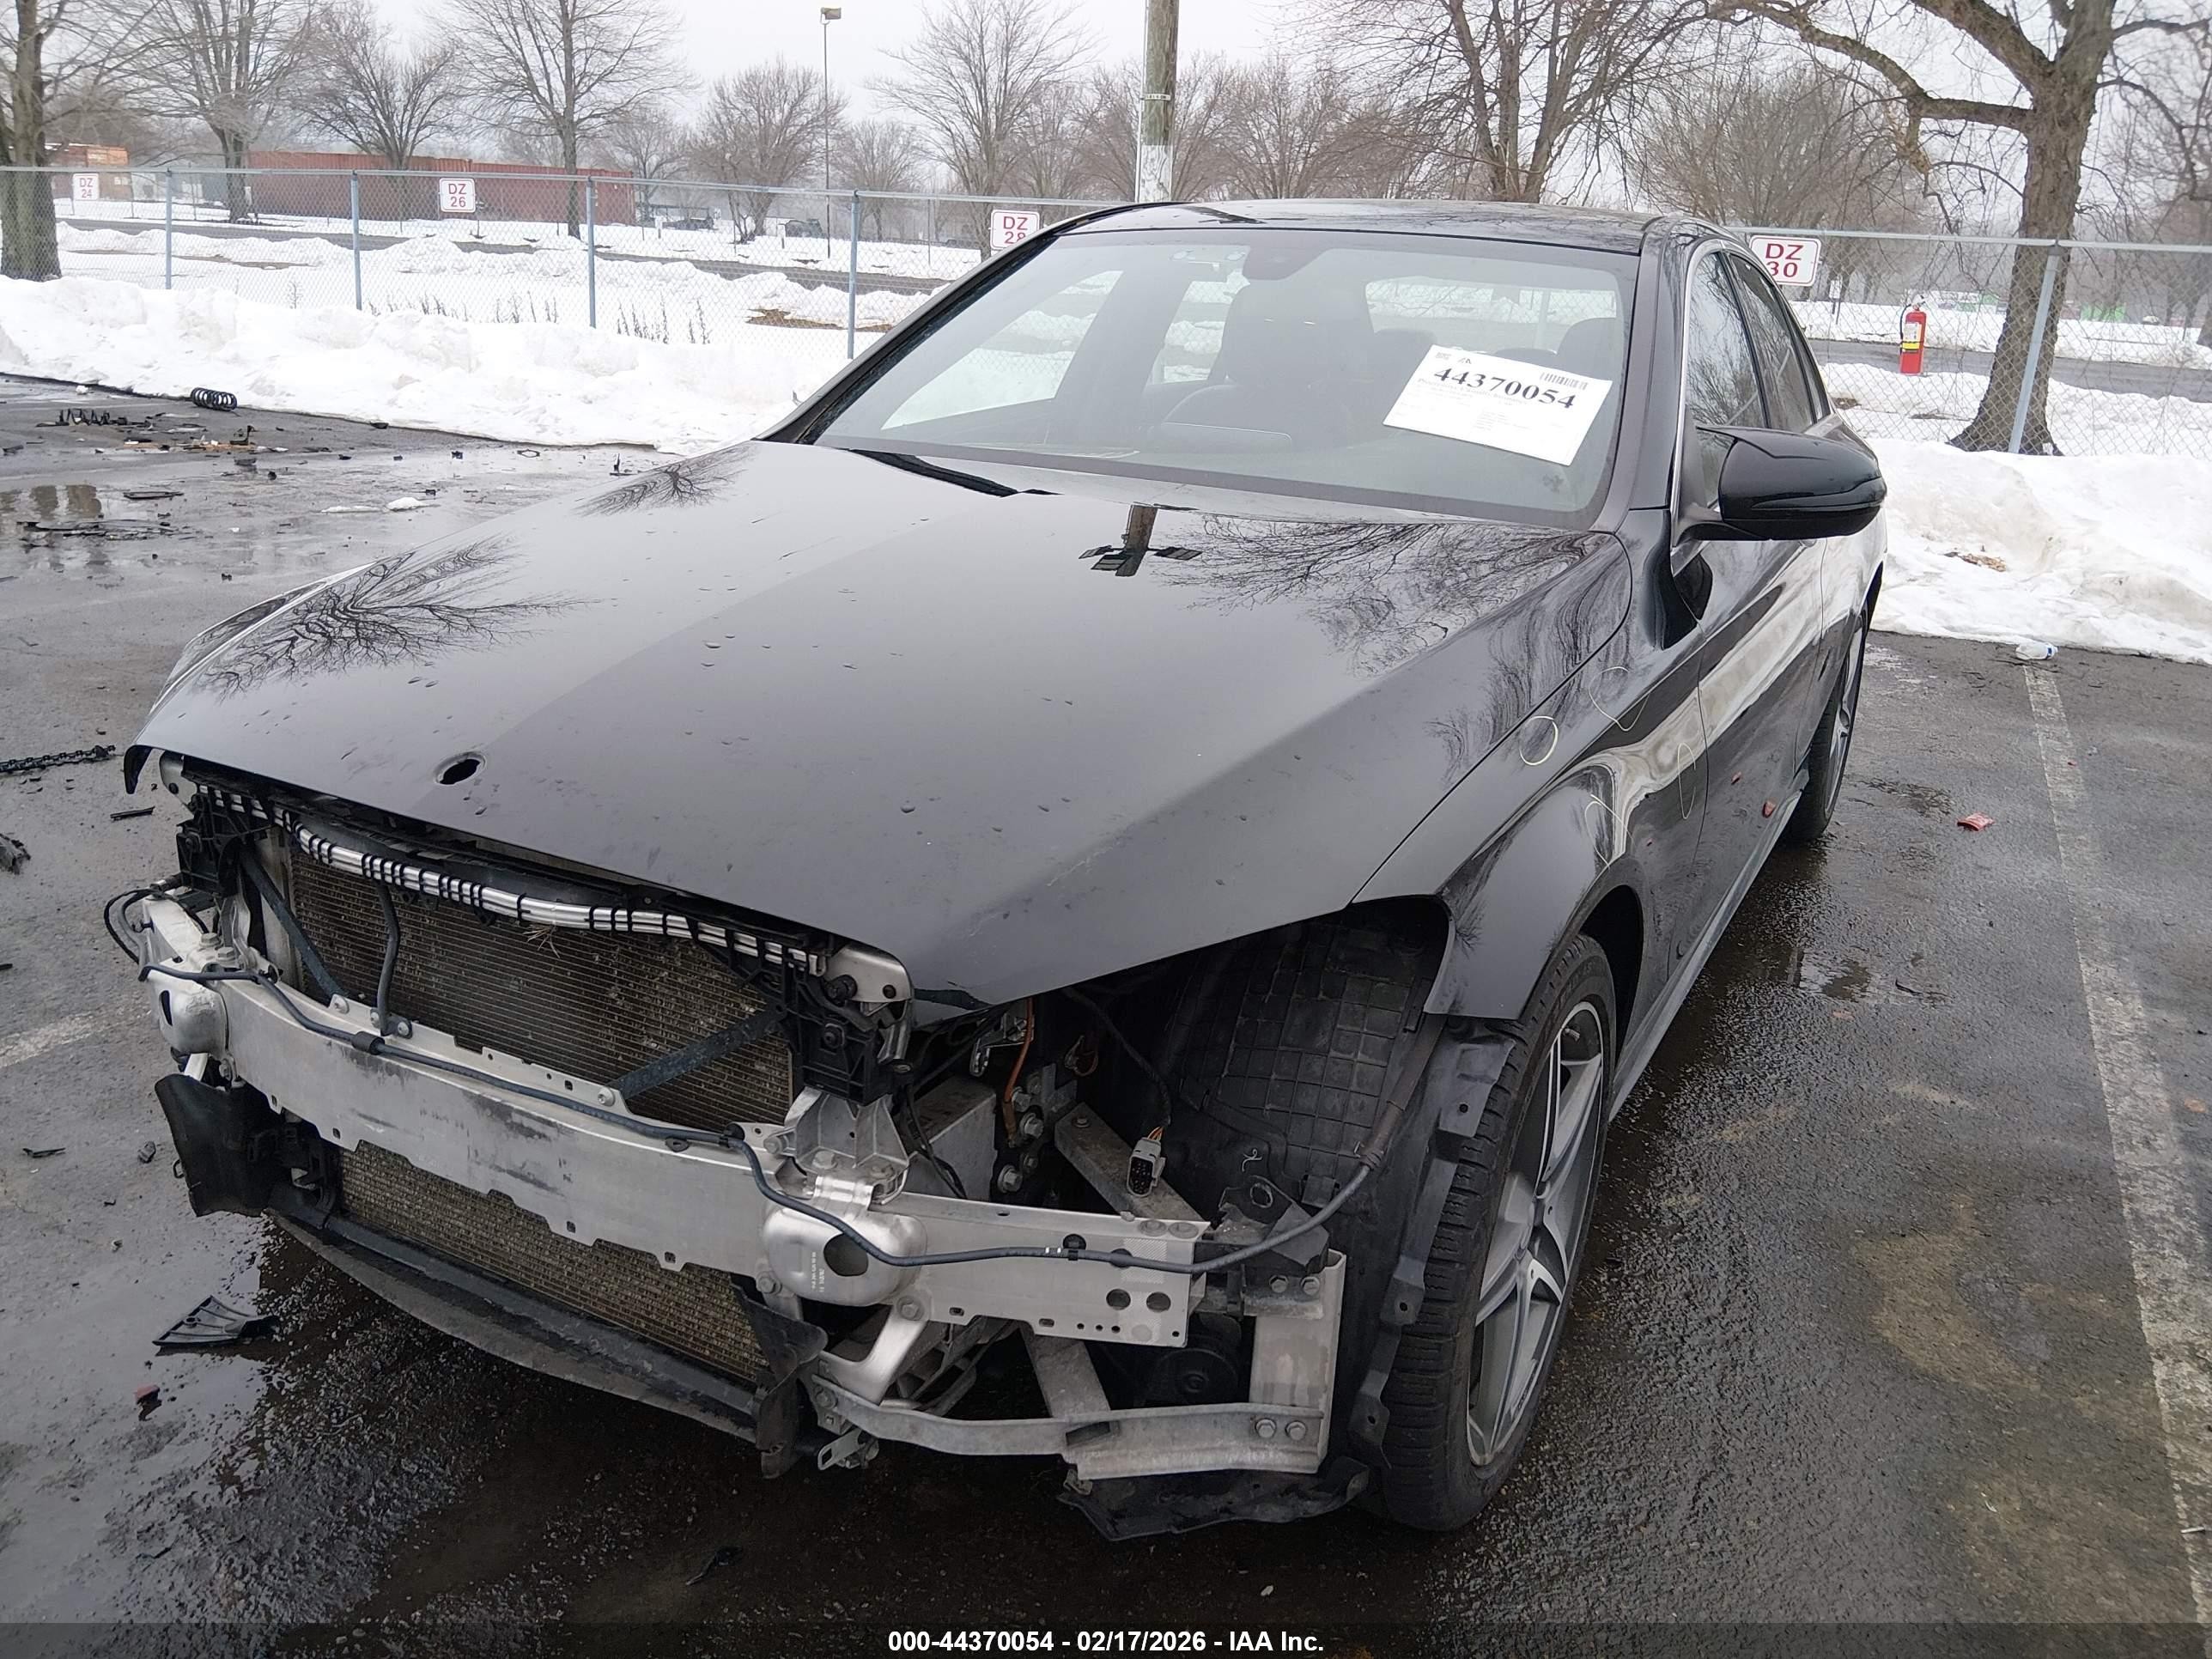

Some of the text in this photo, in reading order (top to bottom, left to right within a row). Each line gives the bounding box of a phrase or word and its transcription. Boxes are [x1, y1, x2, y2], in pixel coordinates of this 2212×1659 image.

[80, 178, 94, 187] DZ
[448, 183, 467, 194] DZ
[82, 189, 93, 198] 24
[450, 197, 466, 208] 26
[1003, 216, 1028, 230] DZ
[1765, 243, 1804, 260] DZ
[1766, 261, 1798, 277] 30
[1433, 368, 1577, 410] 44370054
